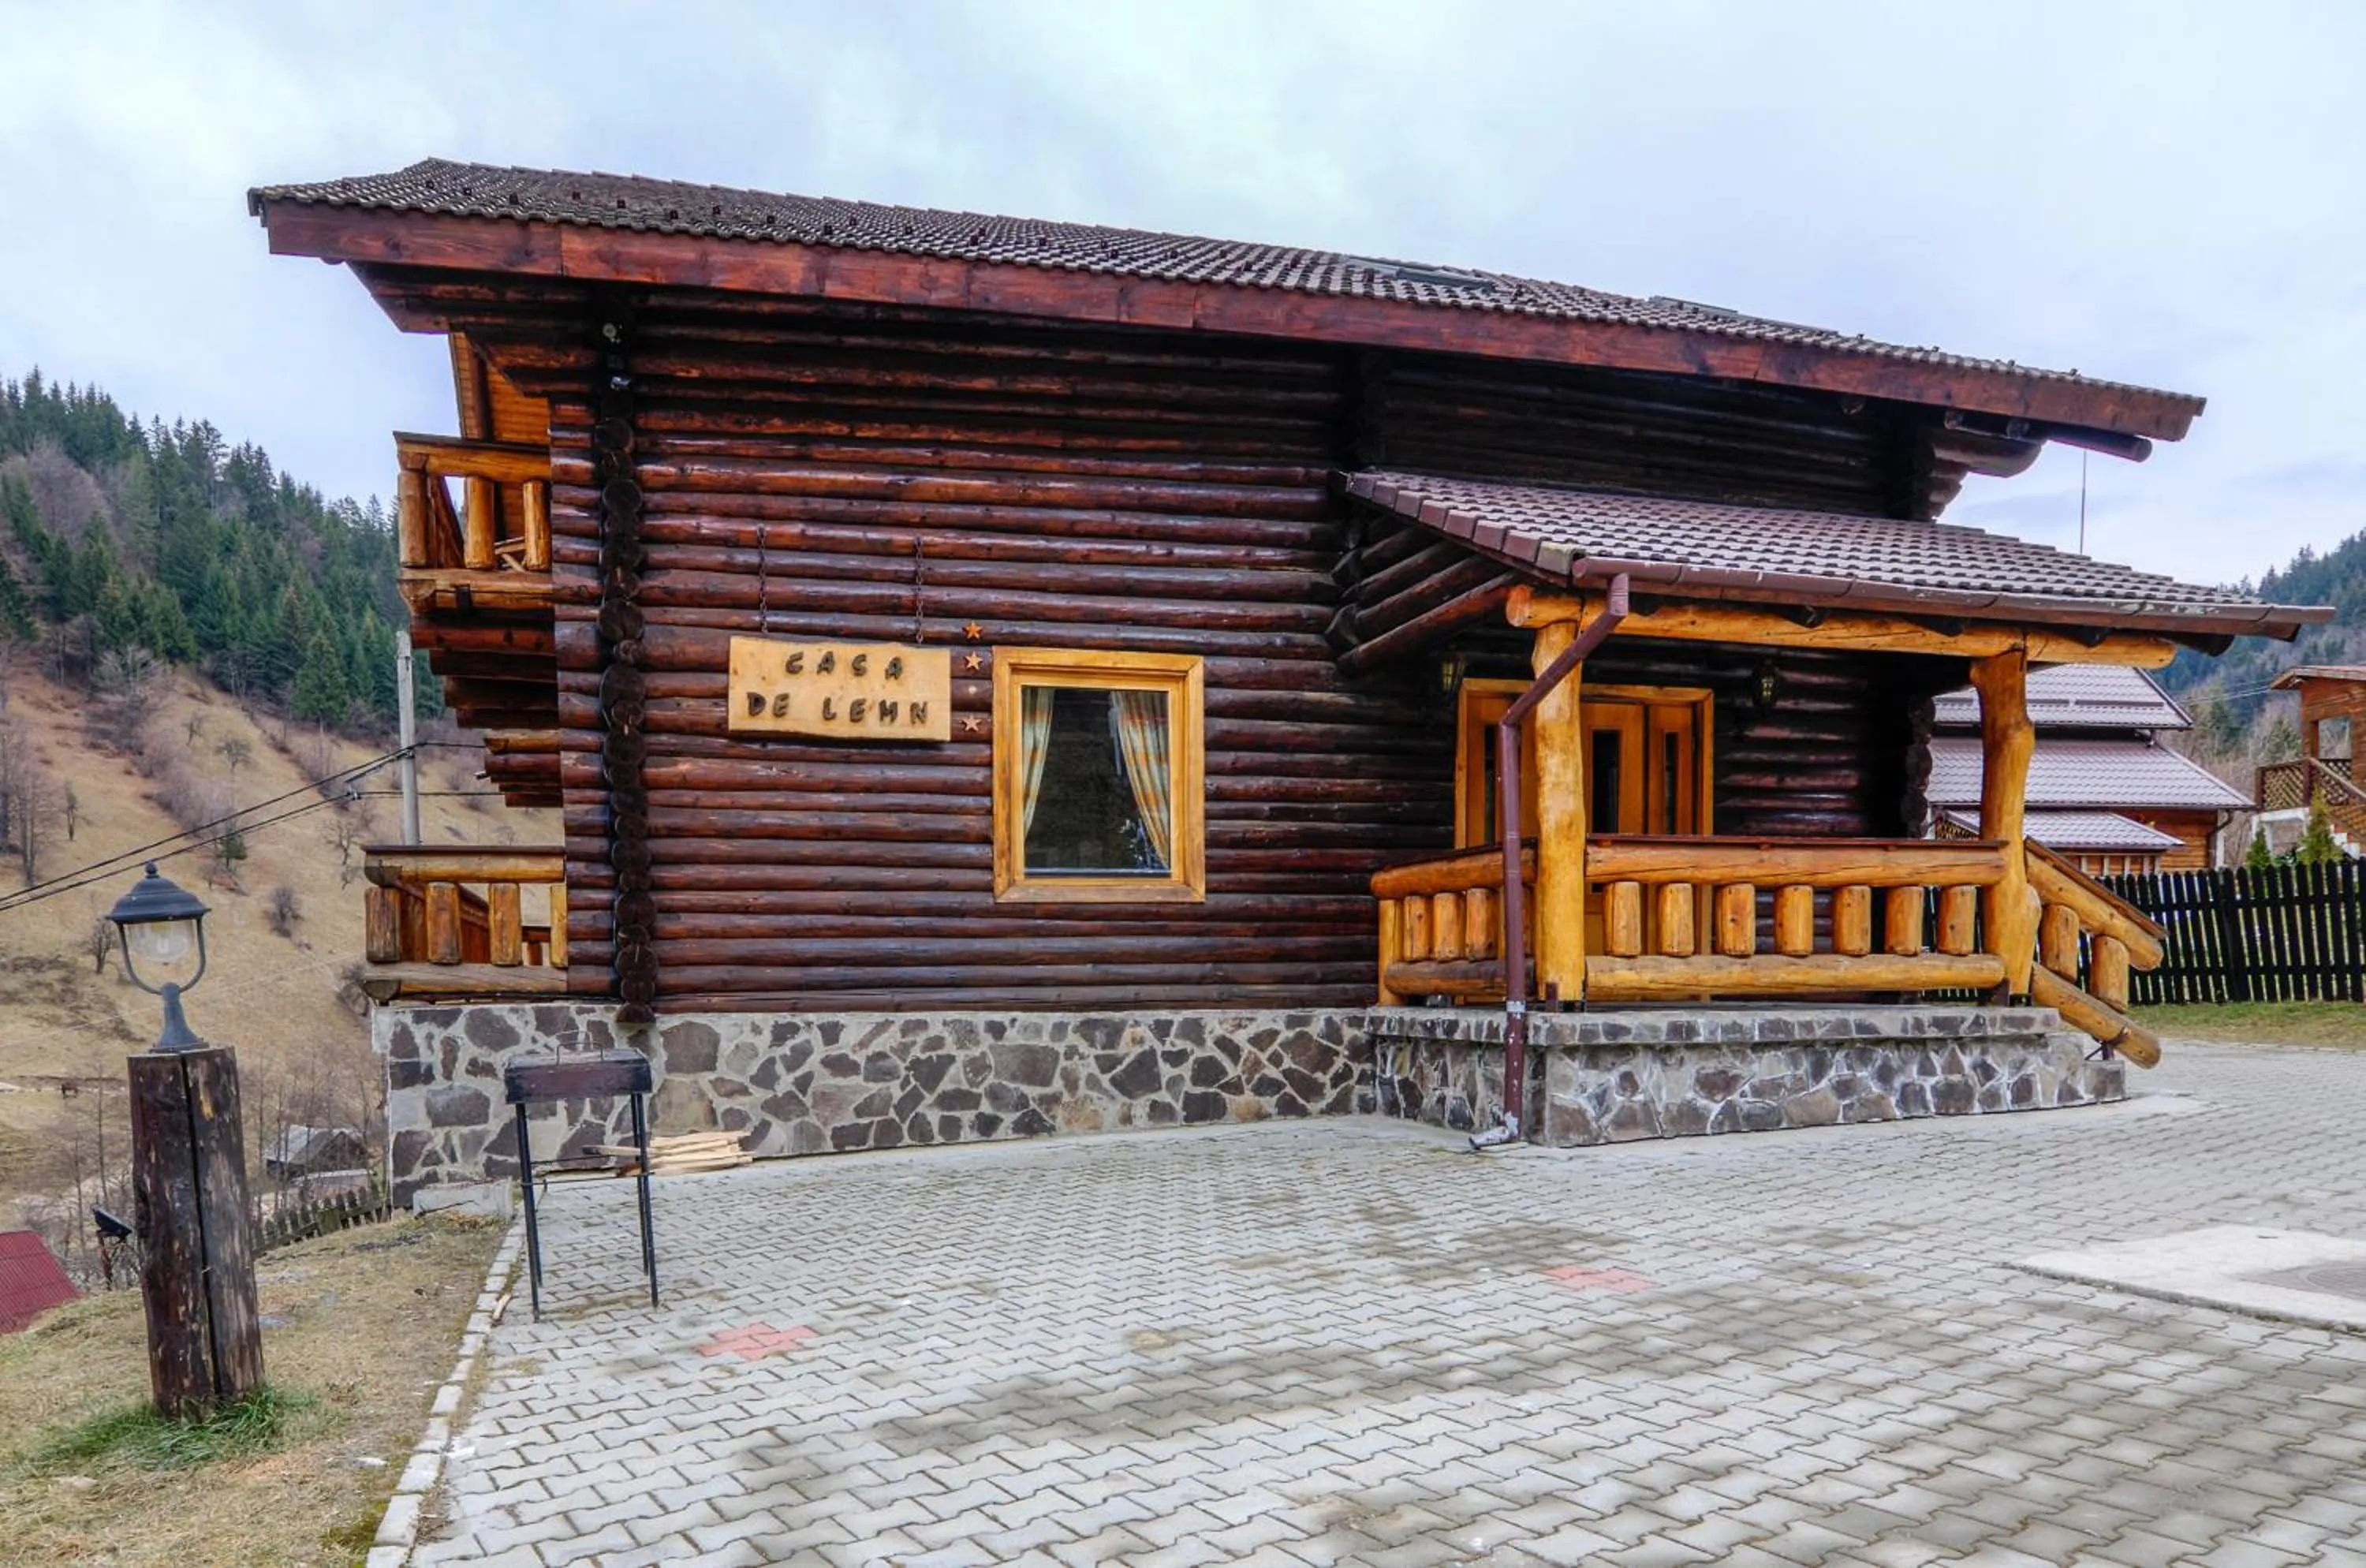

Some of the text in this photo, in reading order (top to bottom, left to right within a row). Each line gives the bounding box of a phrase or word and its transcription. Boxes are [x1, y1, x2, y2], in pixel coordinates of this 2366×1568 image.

[785, 651, 903, 680] CASA
[747, 692, 928, 725] DE LEMN
